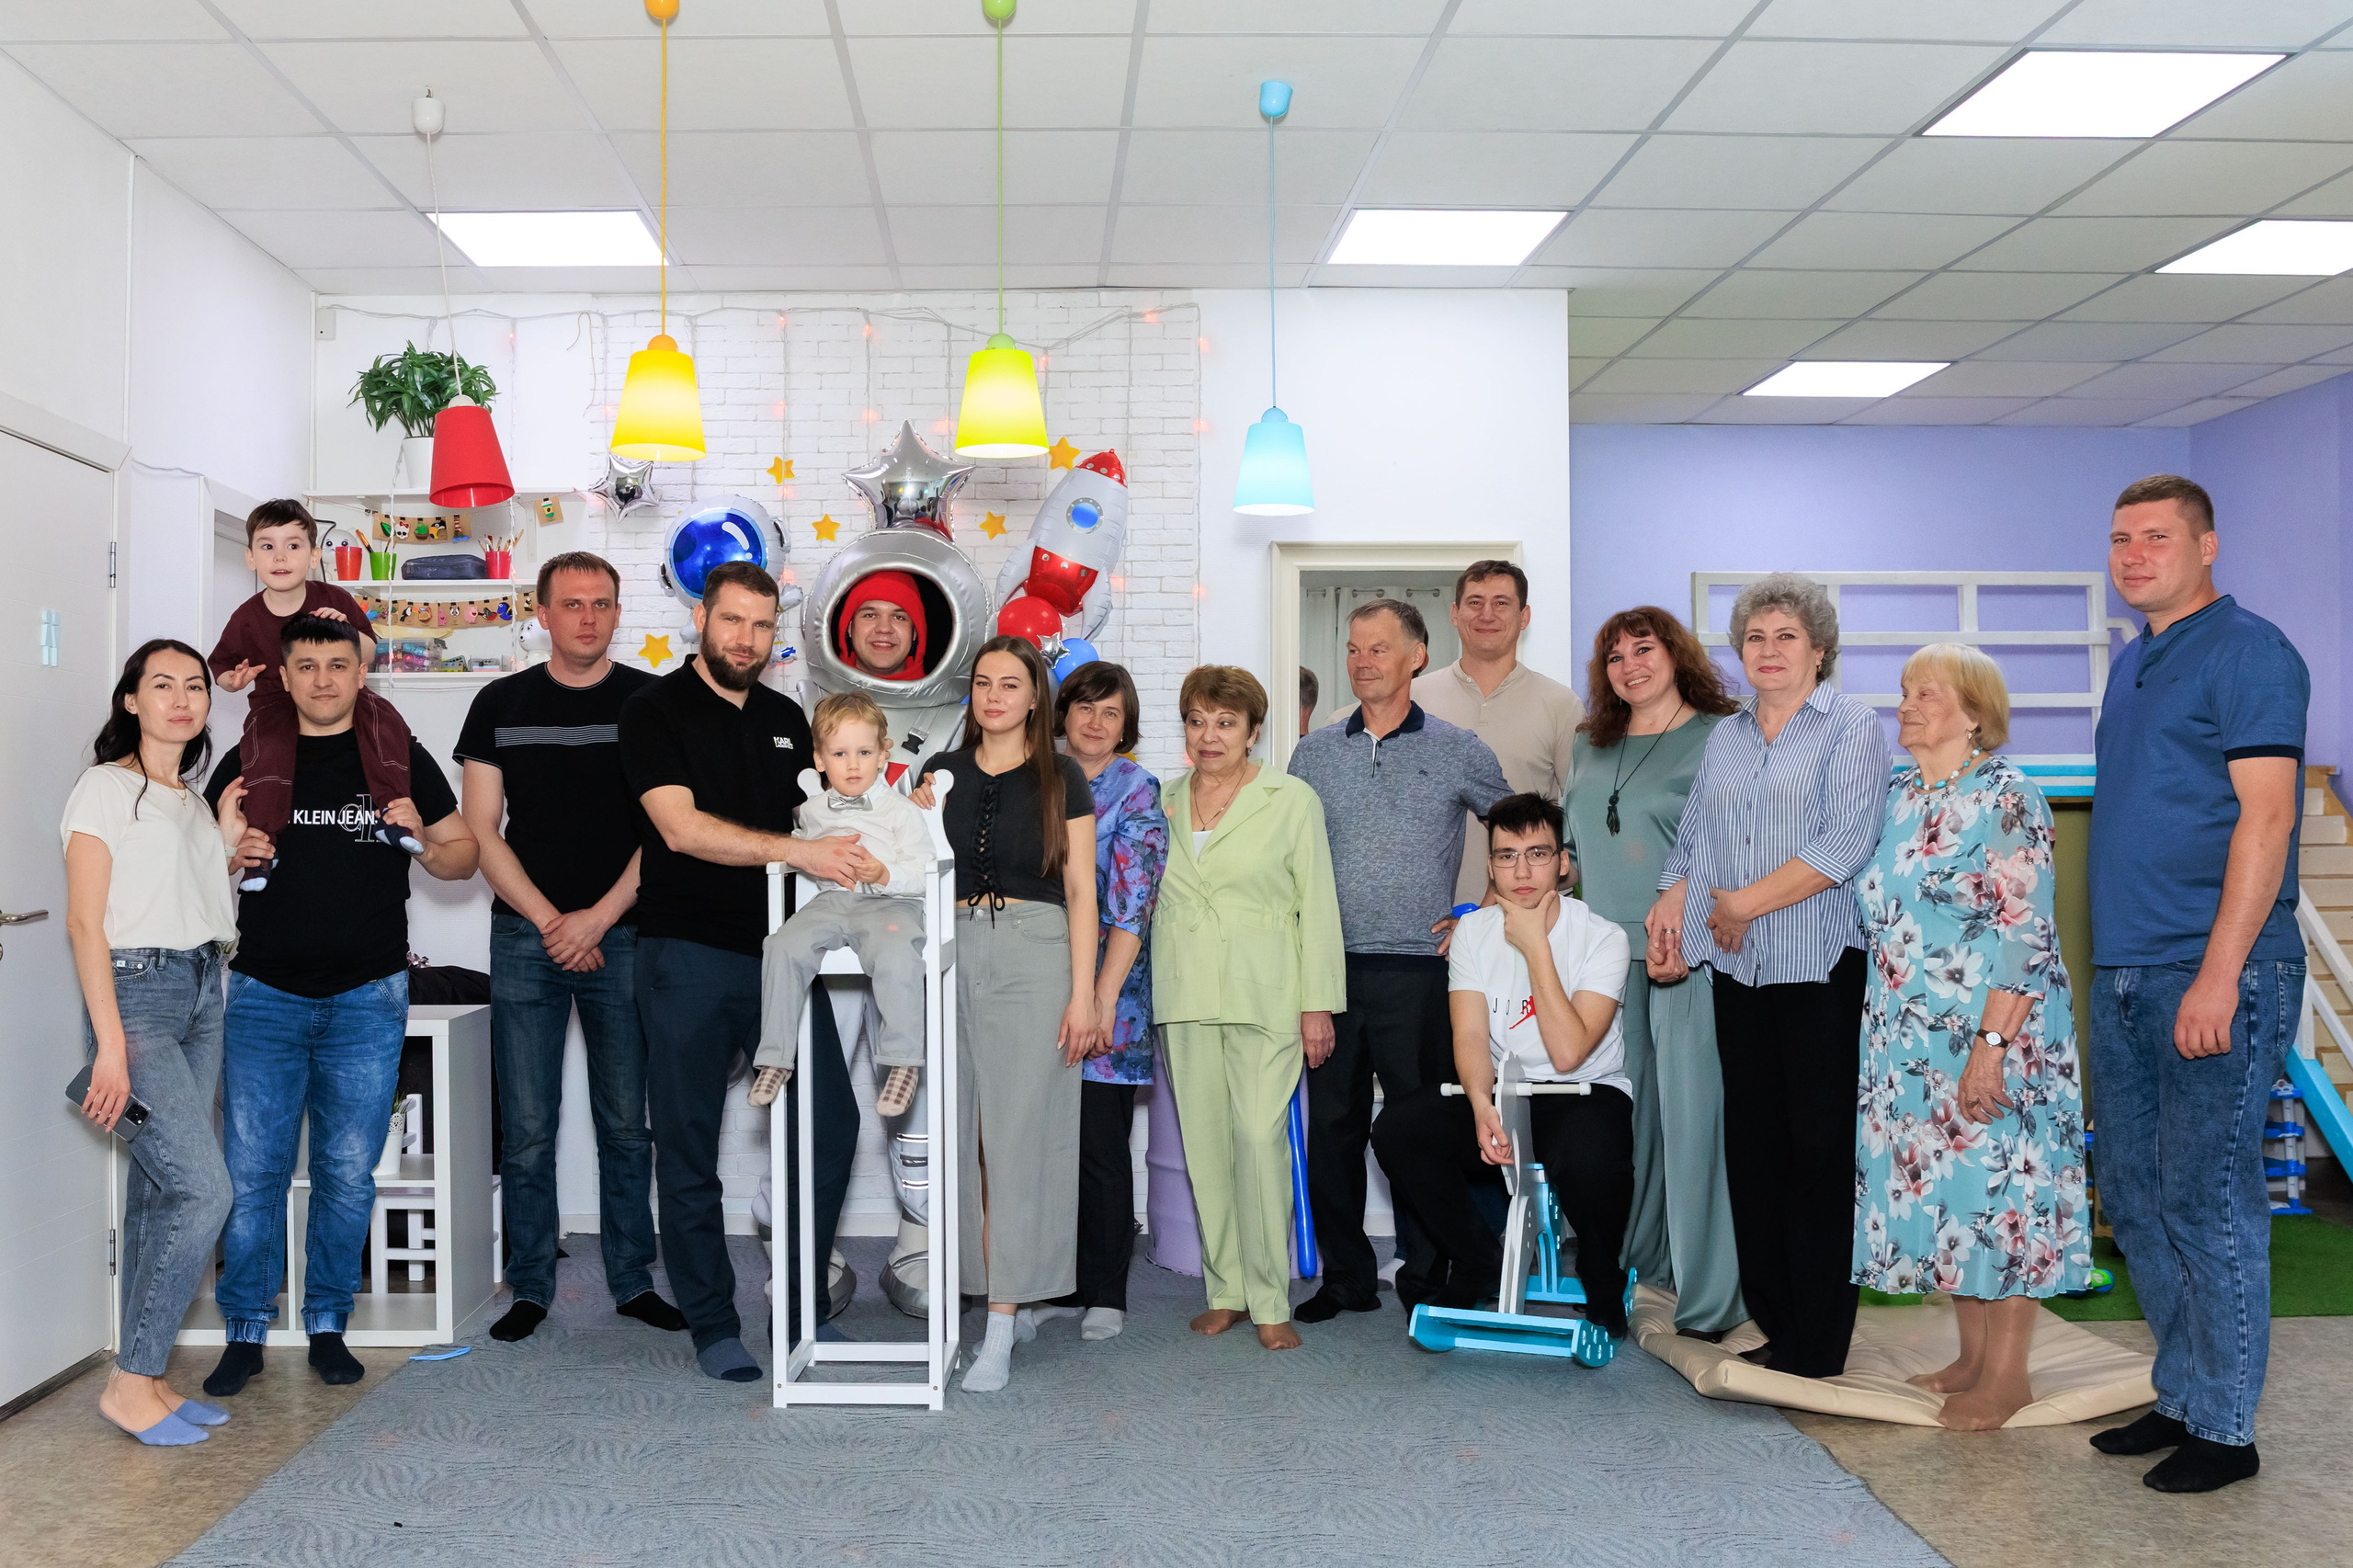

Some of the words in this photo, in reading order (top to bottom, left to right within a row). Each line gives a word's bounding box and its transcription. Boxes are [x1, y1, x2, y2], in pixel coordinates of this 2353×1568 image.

[293, 810, 335, 825] KLEIN
[336, 810, 378, 825] JEAN
[1492, 997, 1529, 1015] JOR
